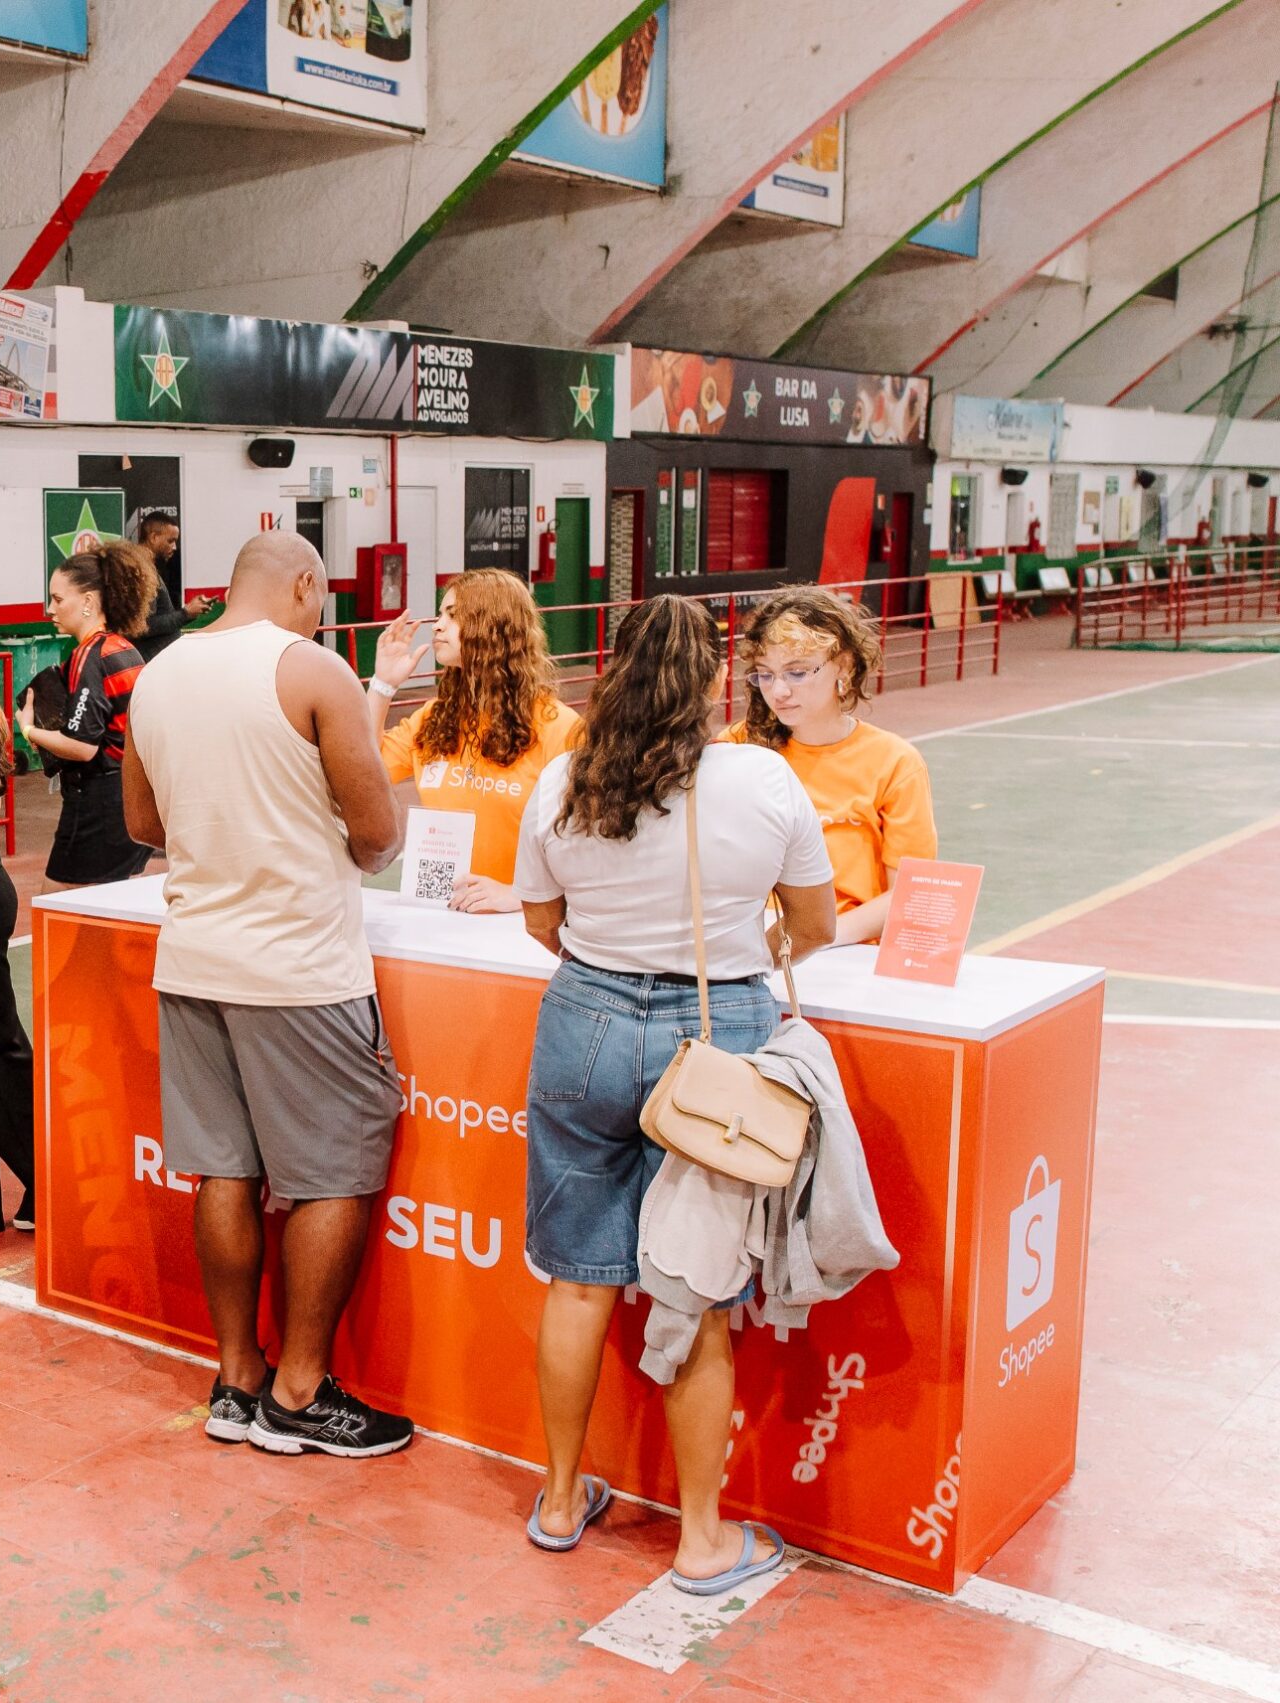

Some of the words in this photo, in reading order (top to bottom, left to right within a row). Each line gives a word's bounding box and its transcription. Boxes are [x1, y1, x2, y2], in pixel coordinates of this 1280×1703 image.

[417, 344, 473, 368] MENEZES
[417, 366, 468, 389] MOURA
[775, 377, 799, 398] BAR
[801, 379, 818, 400] DA
[417, 388, 469, 411] AVELINO
[417, 409, 469, 424] ADVOGADOS
[779, 406, 810, 427] LUSA
[68, 687, 90, 732] Shopee
[447, 765, 522, 797] Shopee
[385, 1195, 502, 1269] SEU
[998, 1323, 1056, 1388] Shopee
[792, 1352, 866, 1484] Shopee
